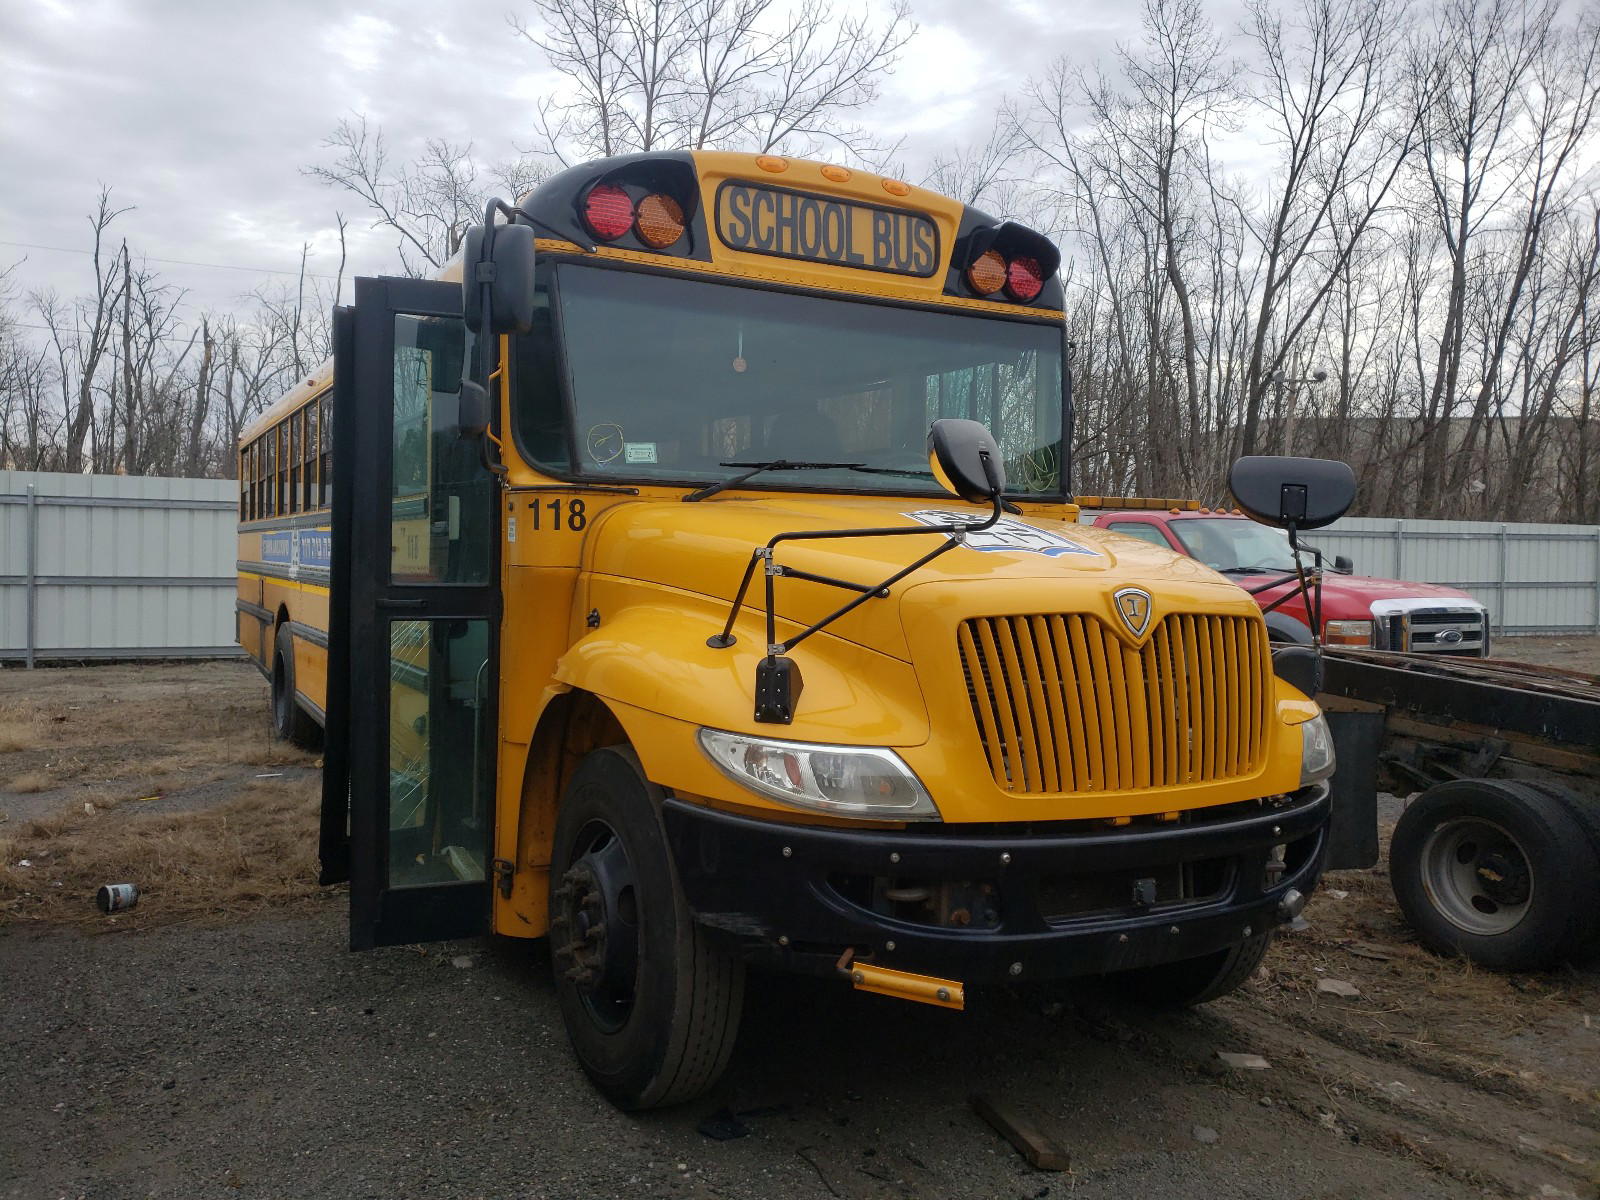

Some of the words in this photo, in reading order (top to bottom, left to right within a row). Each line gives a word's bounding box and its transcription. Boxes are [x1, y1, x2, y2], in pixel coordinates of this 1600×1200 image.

[729, 187, 865, 264] SCHOOL
[873, 210, 933, 273] BUS
[528, 498, 587, 531] 118
